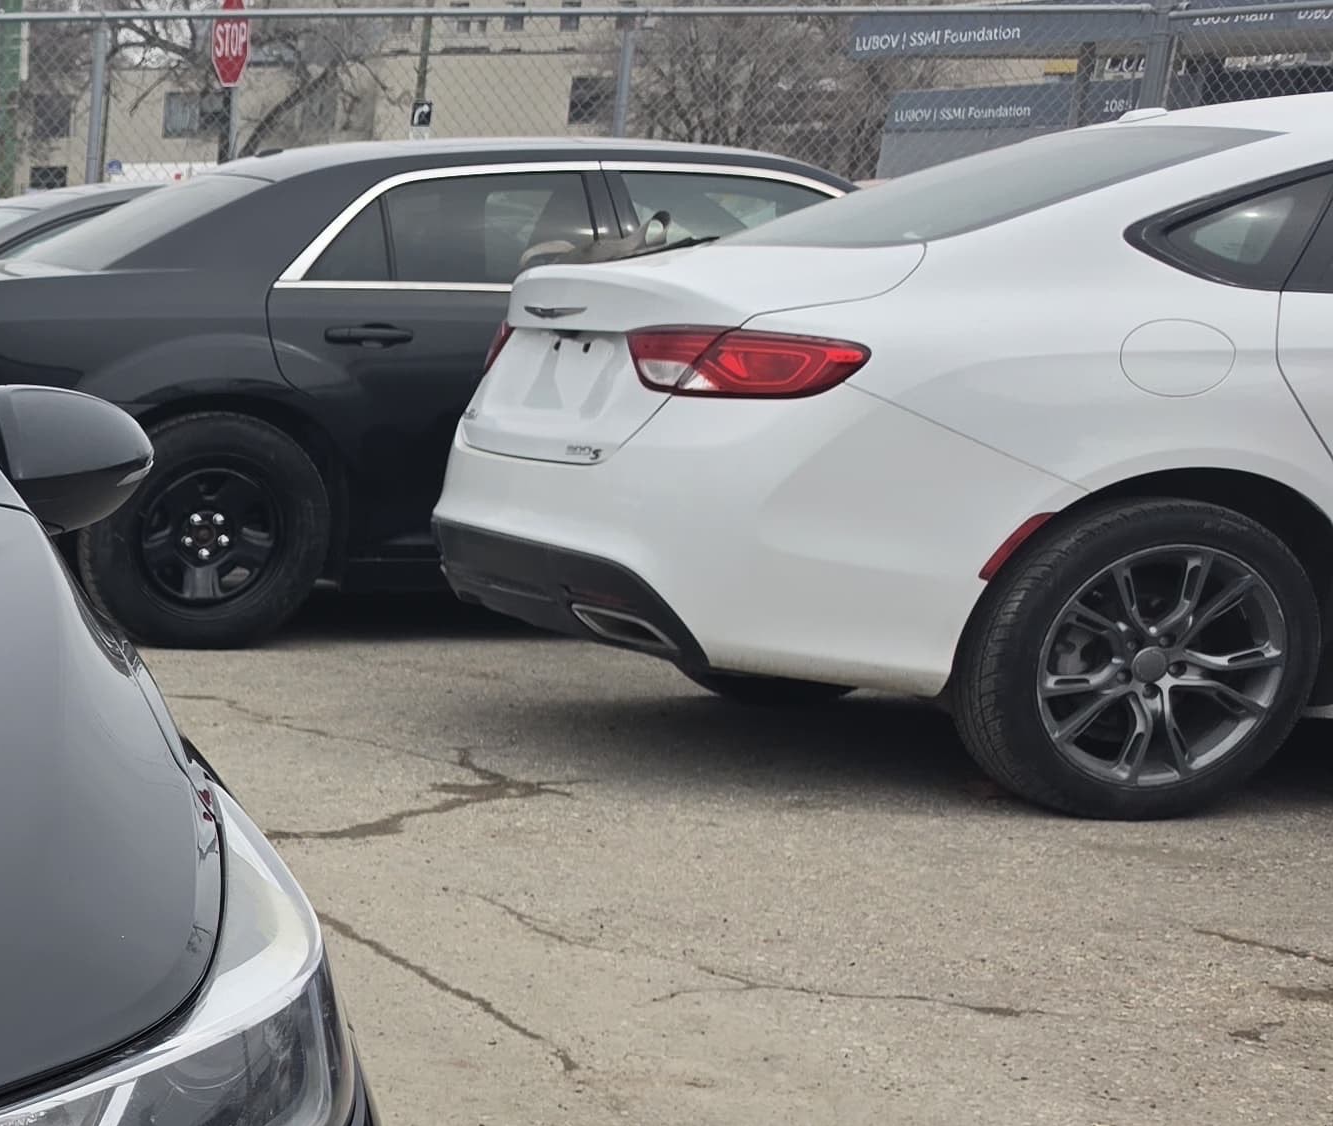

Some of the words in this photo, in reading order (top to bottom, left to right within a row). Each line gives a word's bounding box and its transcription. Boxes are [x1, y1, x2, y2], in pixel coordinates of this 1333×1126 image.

[215, 22, 247, 57] STOP
[855, 33, 900, 51] LUBOV
[909, 31, 940, 47] SSMI
[944, 25, 1021, 44] Foundation
[894, 108, 931, 122] LUBOV
[968, 105, 1031, 119] Foundation
